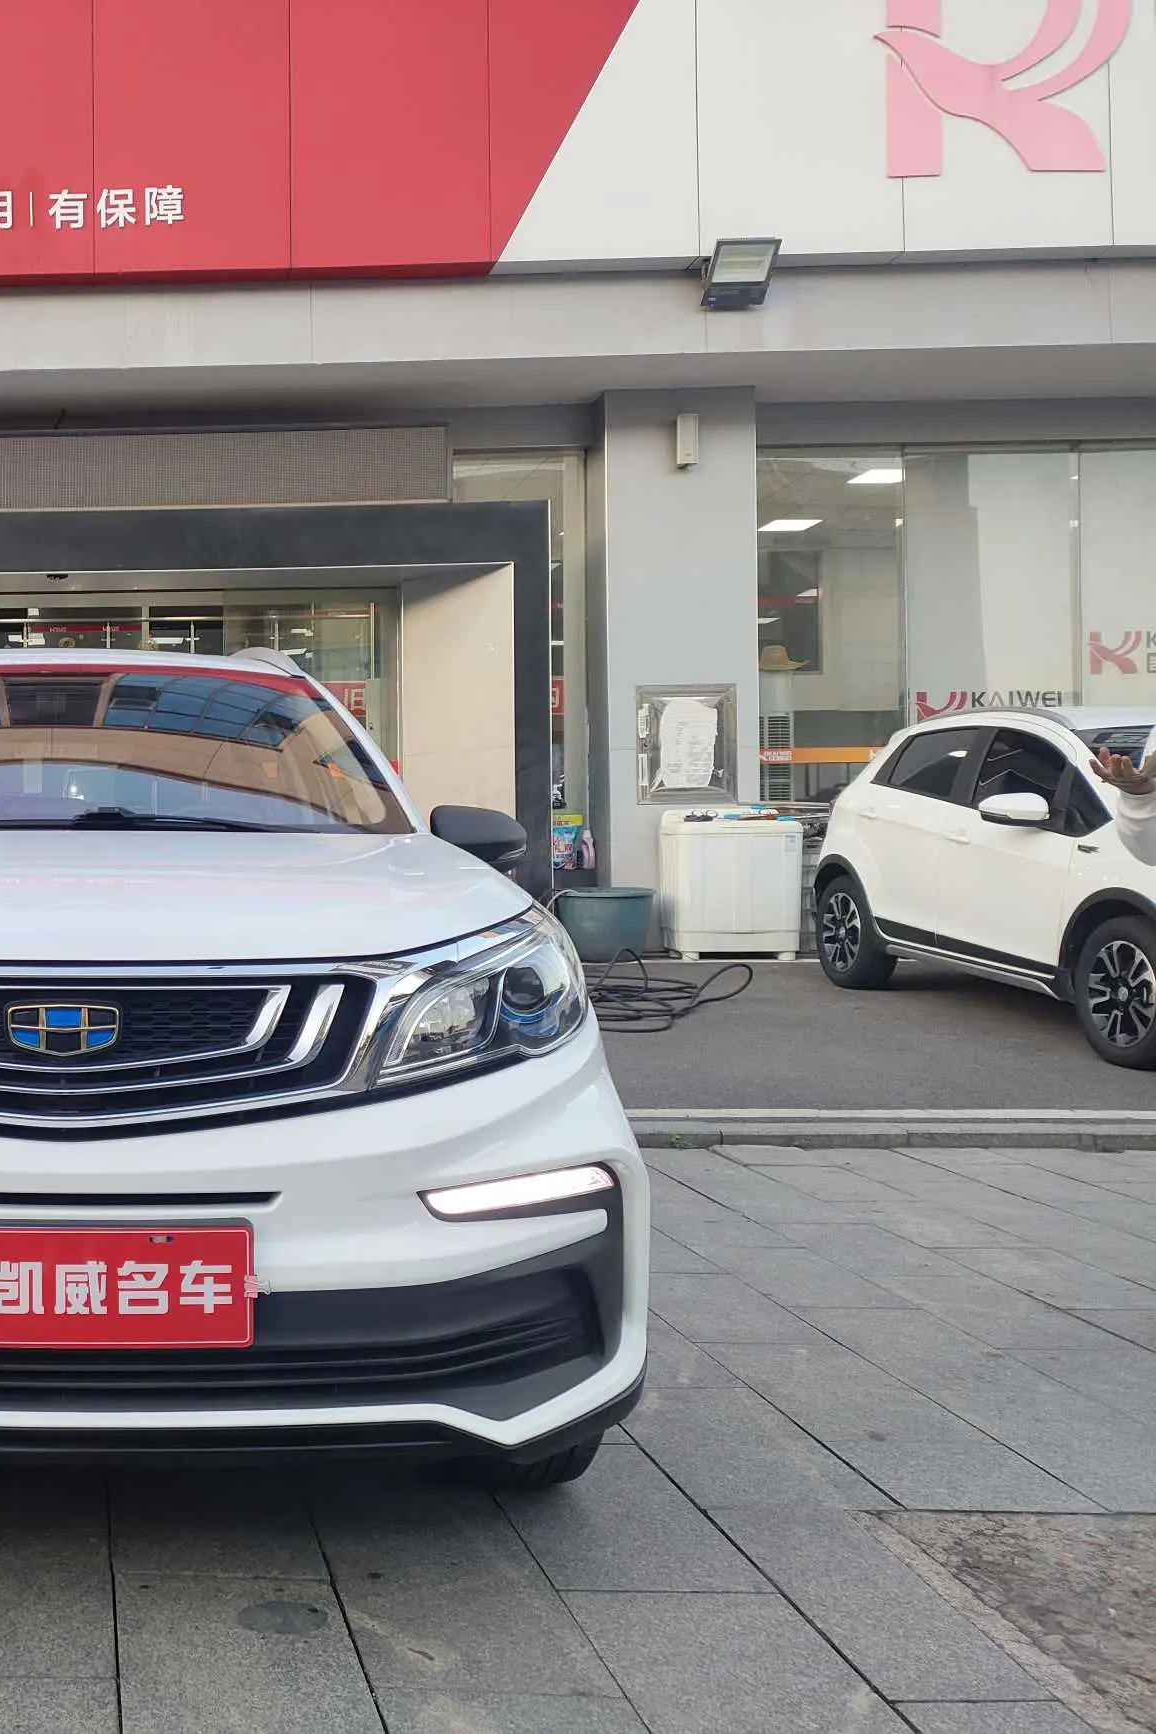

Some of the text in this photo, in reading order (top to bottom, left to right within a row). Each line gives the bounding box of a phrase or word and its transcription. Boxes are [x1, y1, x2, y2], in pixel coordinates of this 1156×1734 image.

[48, 184, 186, 230] 有保障
[971, 689, 1063, 708] KAIWEI
